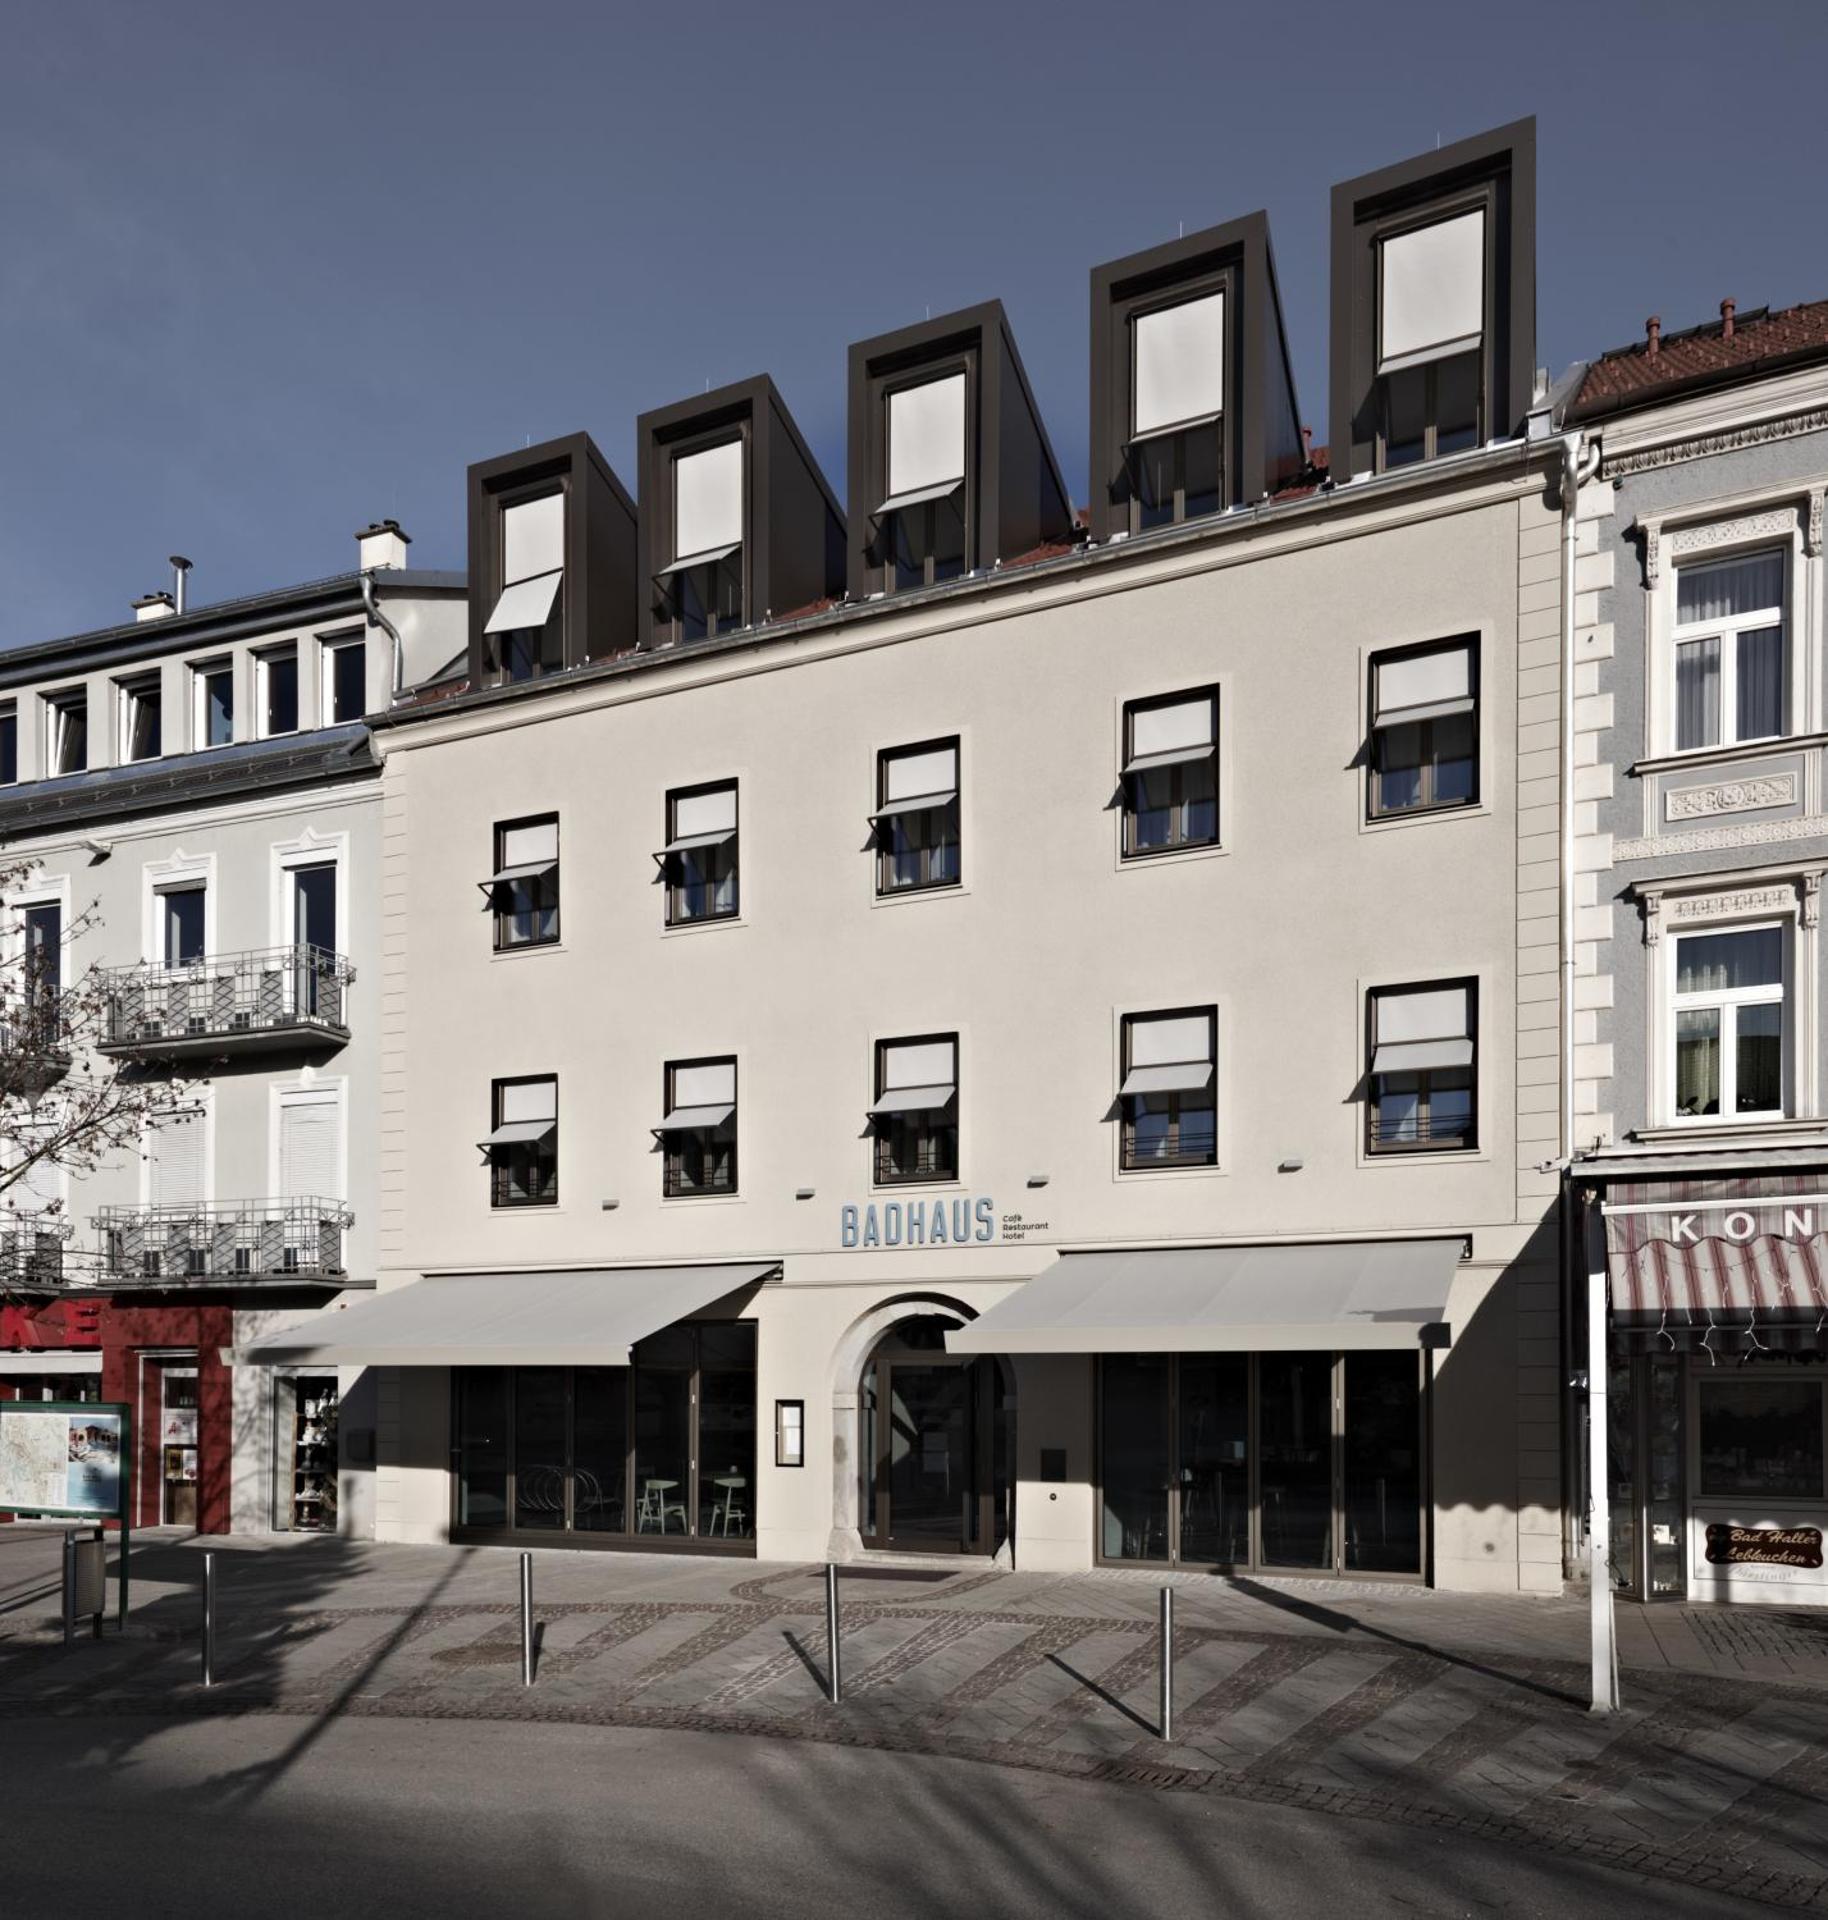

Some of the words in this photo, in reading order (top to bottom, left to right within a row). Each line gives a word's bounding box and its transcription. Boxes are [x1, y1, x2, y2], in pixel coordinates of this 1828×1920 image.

[841, 1197, 994, 1247] BADHAUS
[1002, 1221, 1049, 1231] Restaurant
[1671, 1208, 1813, 1242] KON
[1729, 1529, 1762, 1542] Bad
[1766, 1530, 1818, 1545] Haller
[1727, 1546, 1806, 1564] Lebkuchen
